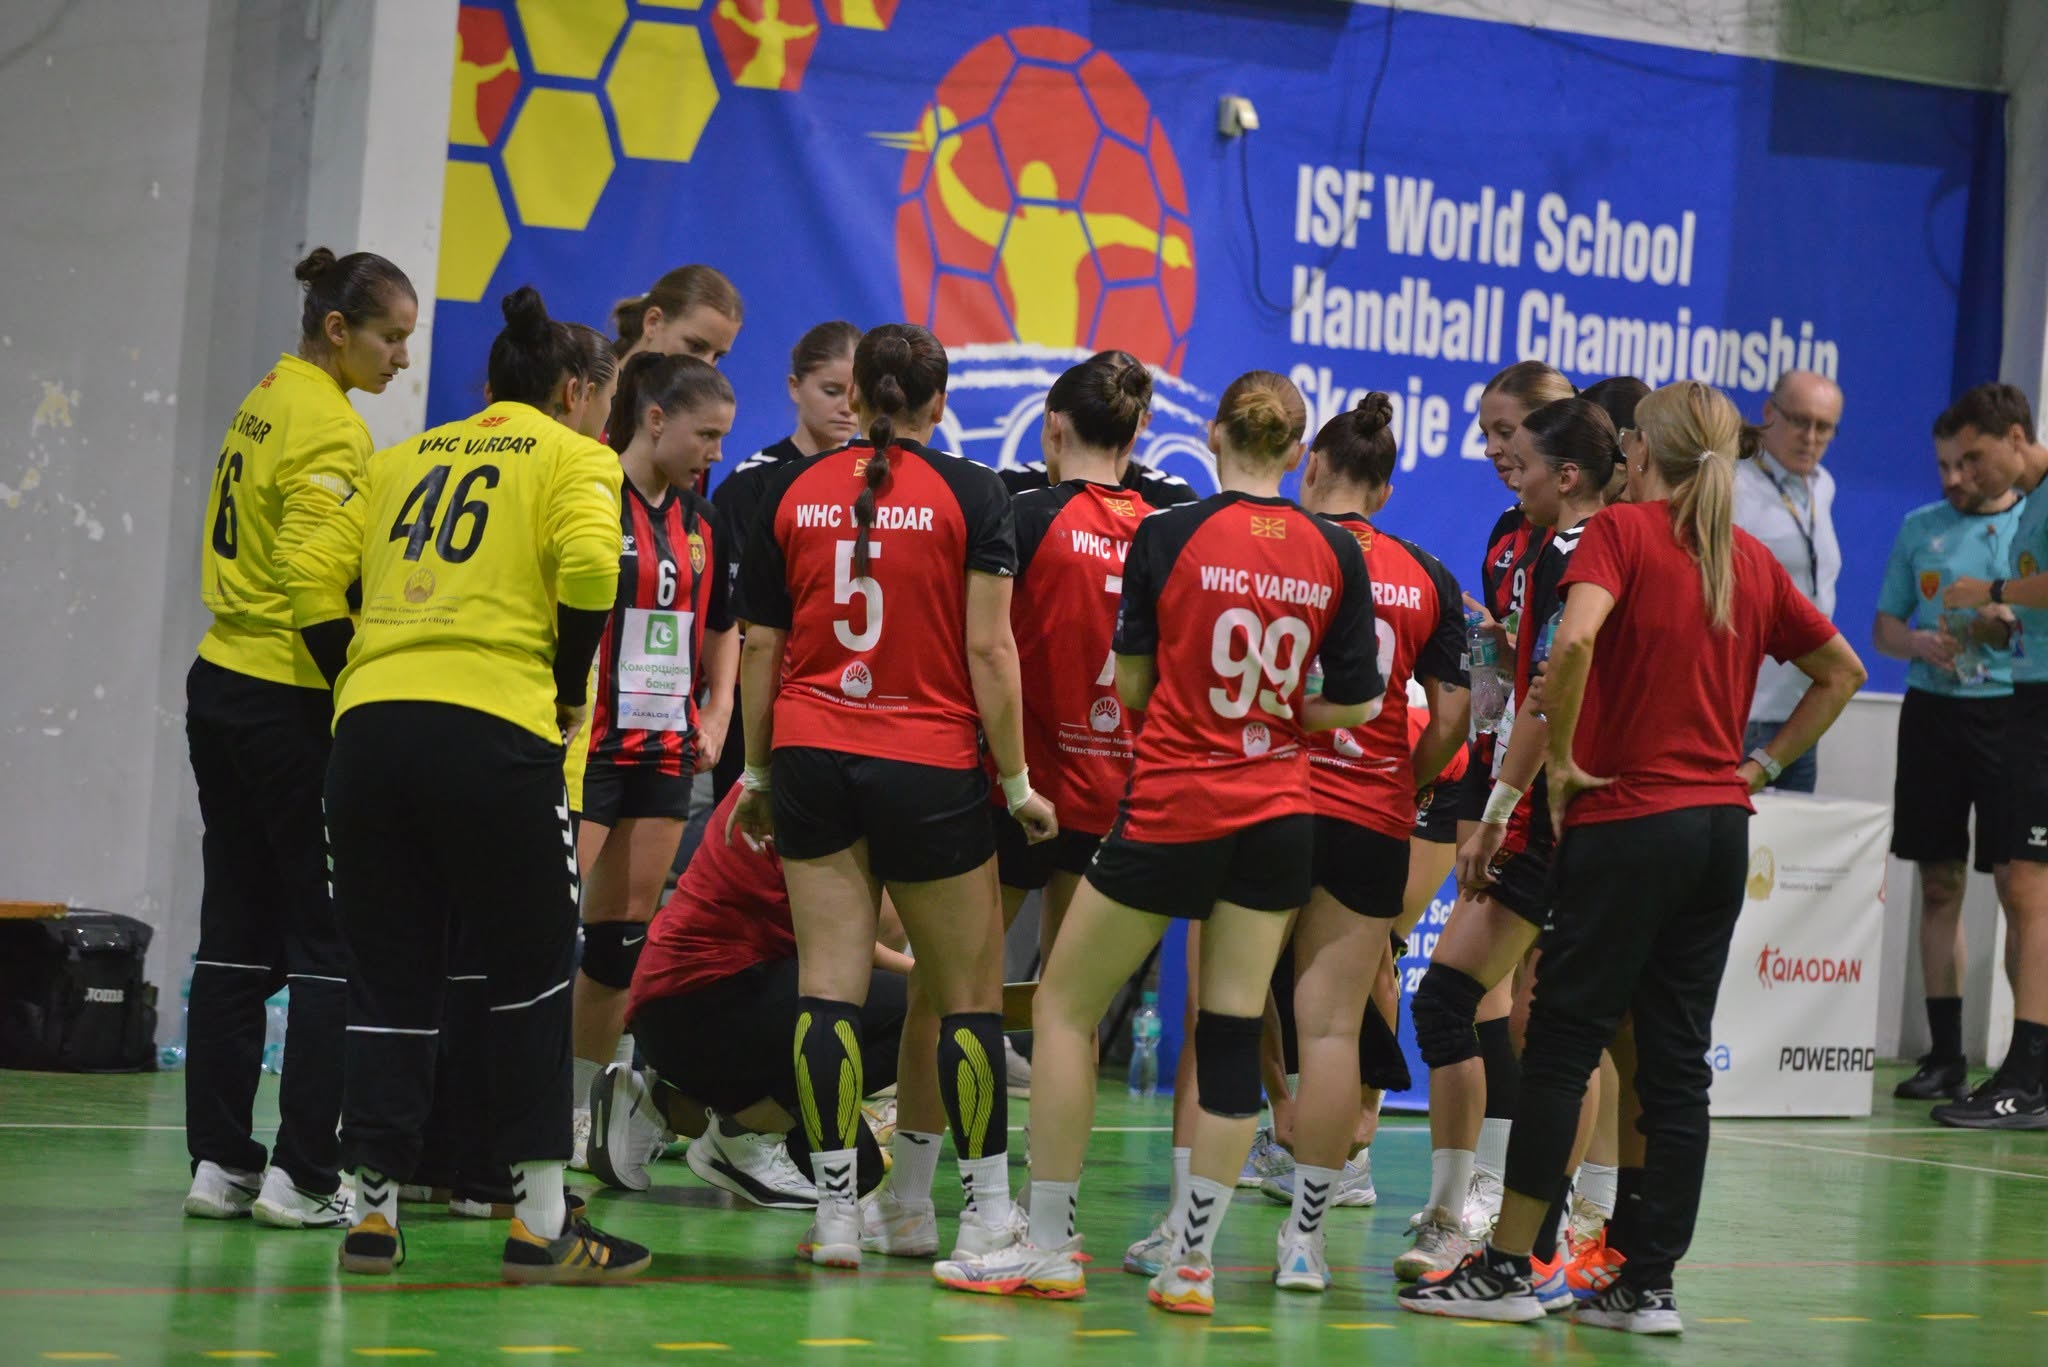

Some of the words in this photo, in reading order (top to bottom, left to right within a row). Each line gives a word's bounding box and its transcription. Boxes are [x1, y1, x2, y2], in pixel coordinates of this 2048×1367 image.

[1296, 164, 1375, 249] ISF
[1384, 174, 1524, 267] World
[1535, 192, 1697, 287] School
[1291, 265, 1504, 364] Handball
[1289, 363, 1450, 472] Skje
[389, 464, 500, 564] 46
[796, 504, 843, 529] WHC
[849, 505, 934, 532] RDAR
[1071, 529, 1111, 560] WHC
[1116, 540, 1134, 563] V
[657, 559, 677, 607] 6
[833, 539, 884, 652] 5
[1200, 565, 1250, 595] WHC
[1254, 572, 1333, 611] VARDAR
[1510, 567, 1526, 610] 9
[1208, 608, 1311, 720] 99
[1429, 898, 1456, 925] Sc
[1422, 932, 1440, 958] C
[1773, 957, 1862, 983] QIAODAN
[1778, 1047, 1876, 1072] POWERAD
